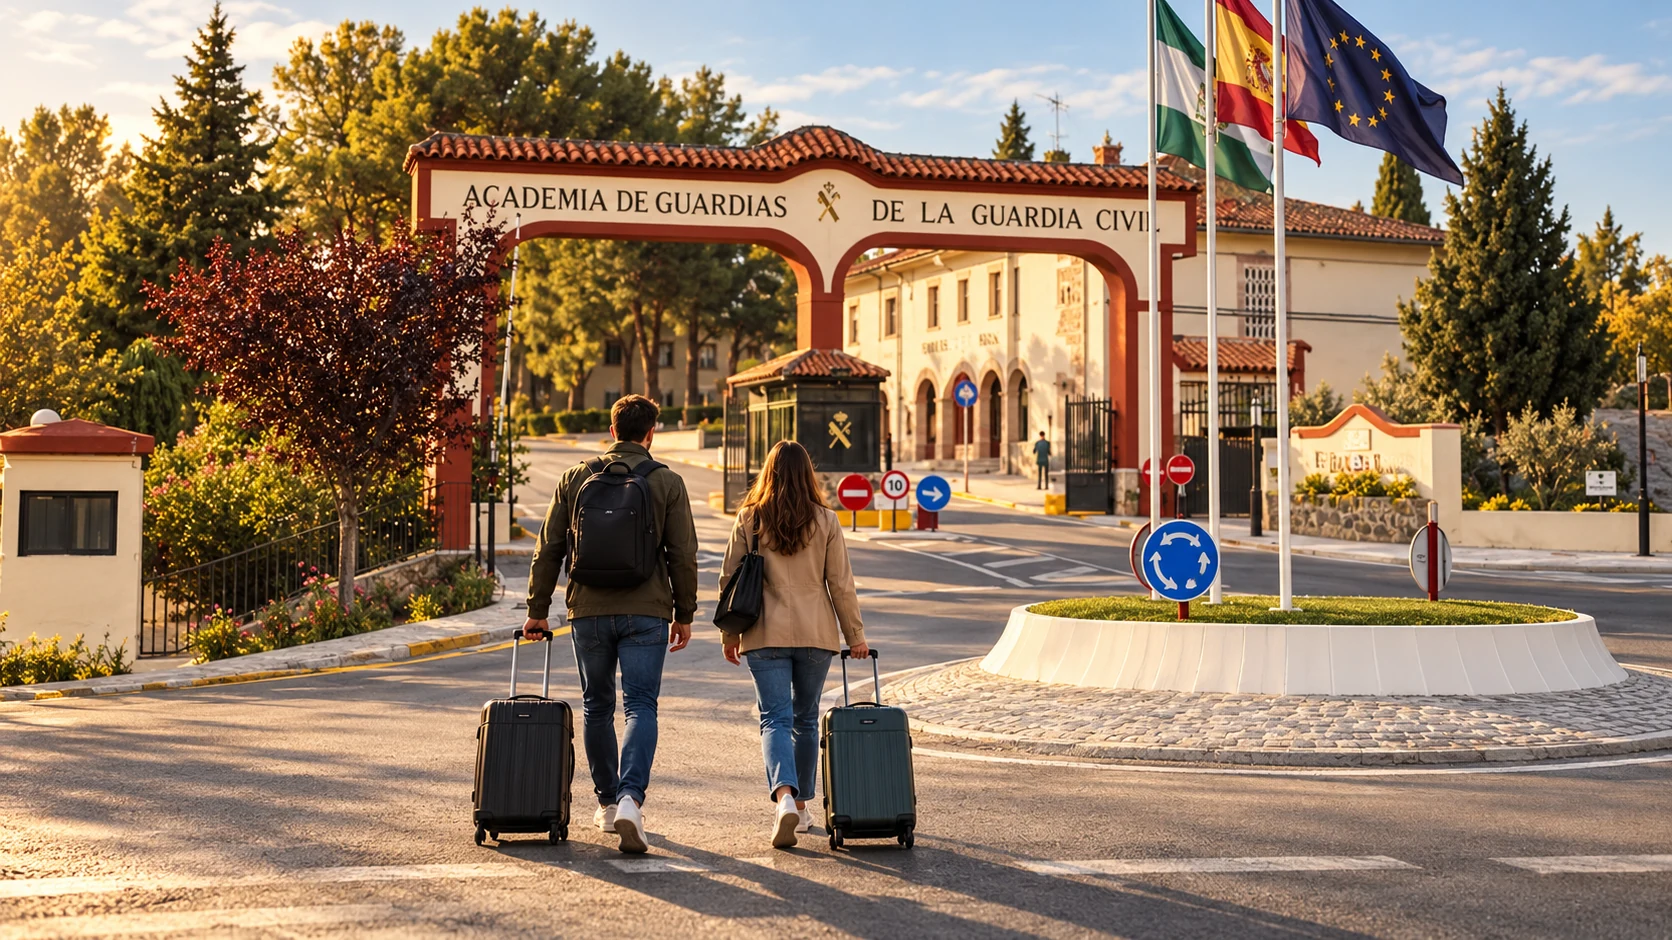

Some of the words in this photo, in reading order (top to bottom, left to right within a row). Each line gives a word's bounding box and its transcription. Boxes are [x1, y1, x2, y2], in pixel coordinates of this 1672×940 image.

[462, 184, 608, 213] ACADEMIA
[617, 190, 649, 213] DE
[655, 191, 787, 218] GUARDIAS
[872, 199, 905, 223] DE
[921, 201, 955, 224] LA
[971, 204, 1083, 230] GUARDIA
[888, 480, 903, 491] 10
